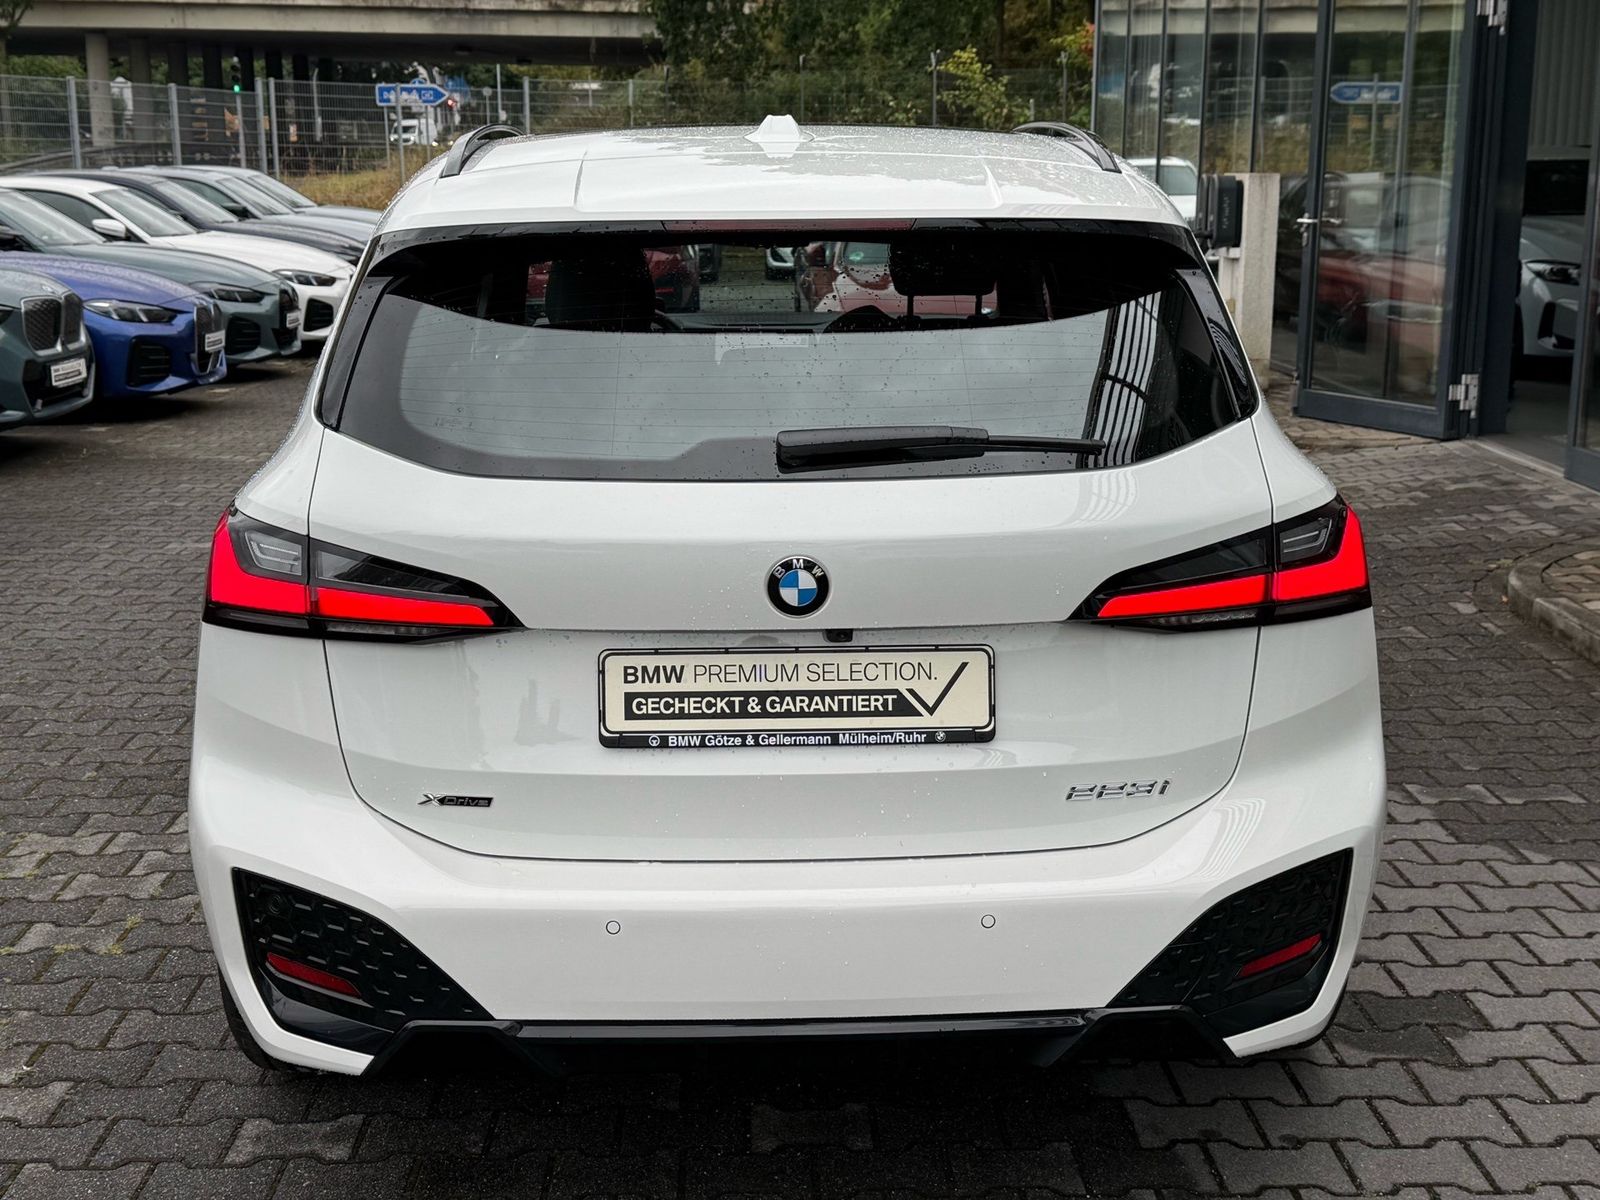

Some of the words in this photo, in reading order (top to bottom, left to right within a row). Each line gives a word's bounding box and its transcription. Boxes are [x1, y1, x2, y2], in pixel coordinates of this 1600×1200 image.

[773, 558, 825, 579] BMW
[623, 664, 685, 684] BMW
[693, 663, 800, 684] PREMIUM
[806, 661, 938, 682] SELECTION.
[631, 696, 744, 715] GECHECKT
[747, 696, 762, 713] &
[765, 694, 898, 714] GARANTIERT
[668, 735, 702, 747] BMW
[705, 733, 742, 746] Götze
[745, 734, 755, 746] &
[758, 732, 832, 746] Gellermann
[838, 731, 927, 745] Mülheim/Ruhr
[1065, 779, 1171, 801] 223i
